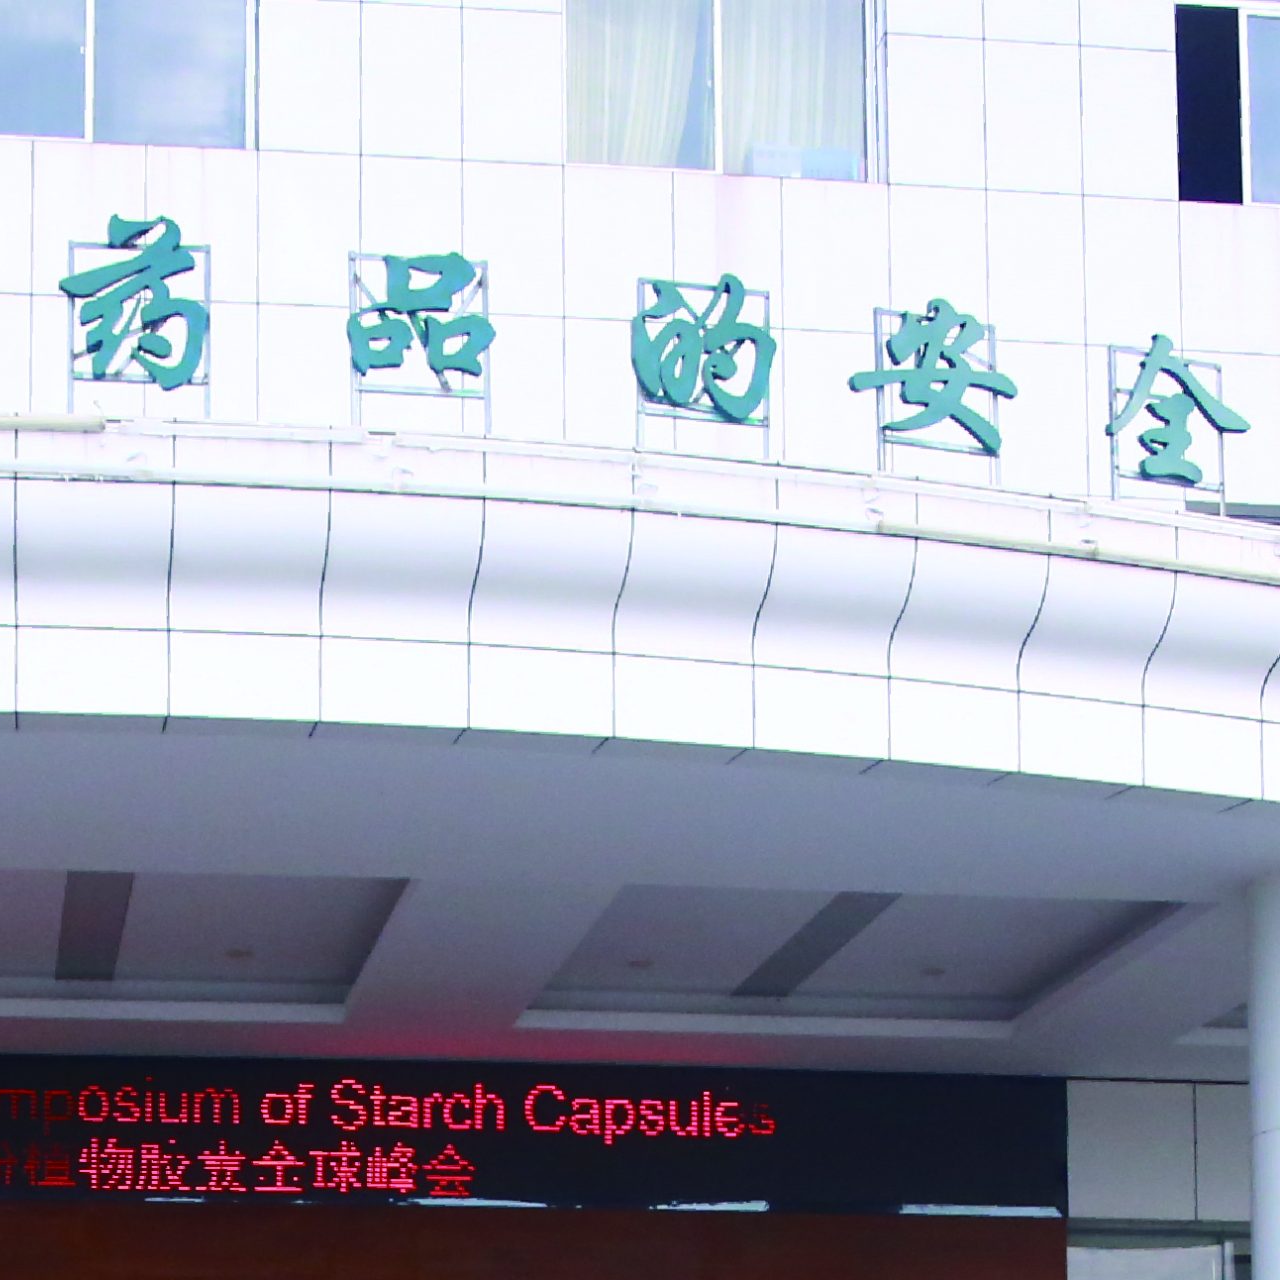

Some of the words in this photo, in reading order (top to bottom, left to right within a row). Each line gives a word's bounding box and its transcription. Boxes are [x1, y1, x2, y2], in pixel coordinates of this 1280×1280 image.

[260, 1085, 315, 1126] of
[330, 1078, 505, 1132] Starch
[523, 1084, 776, 1144] Capsules
